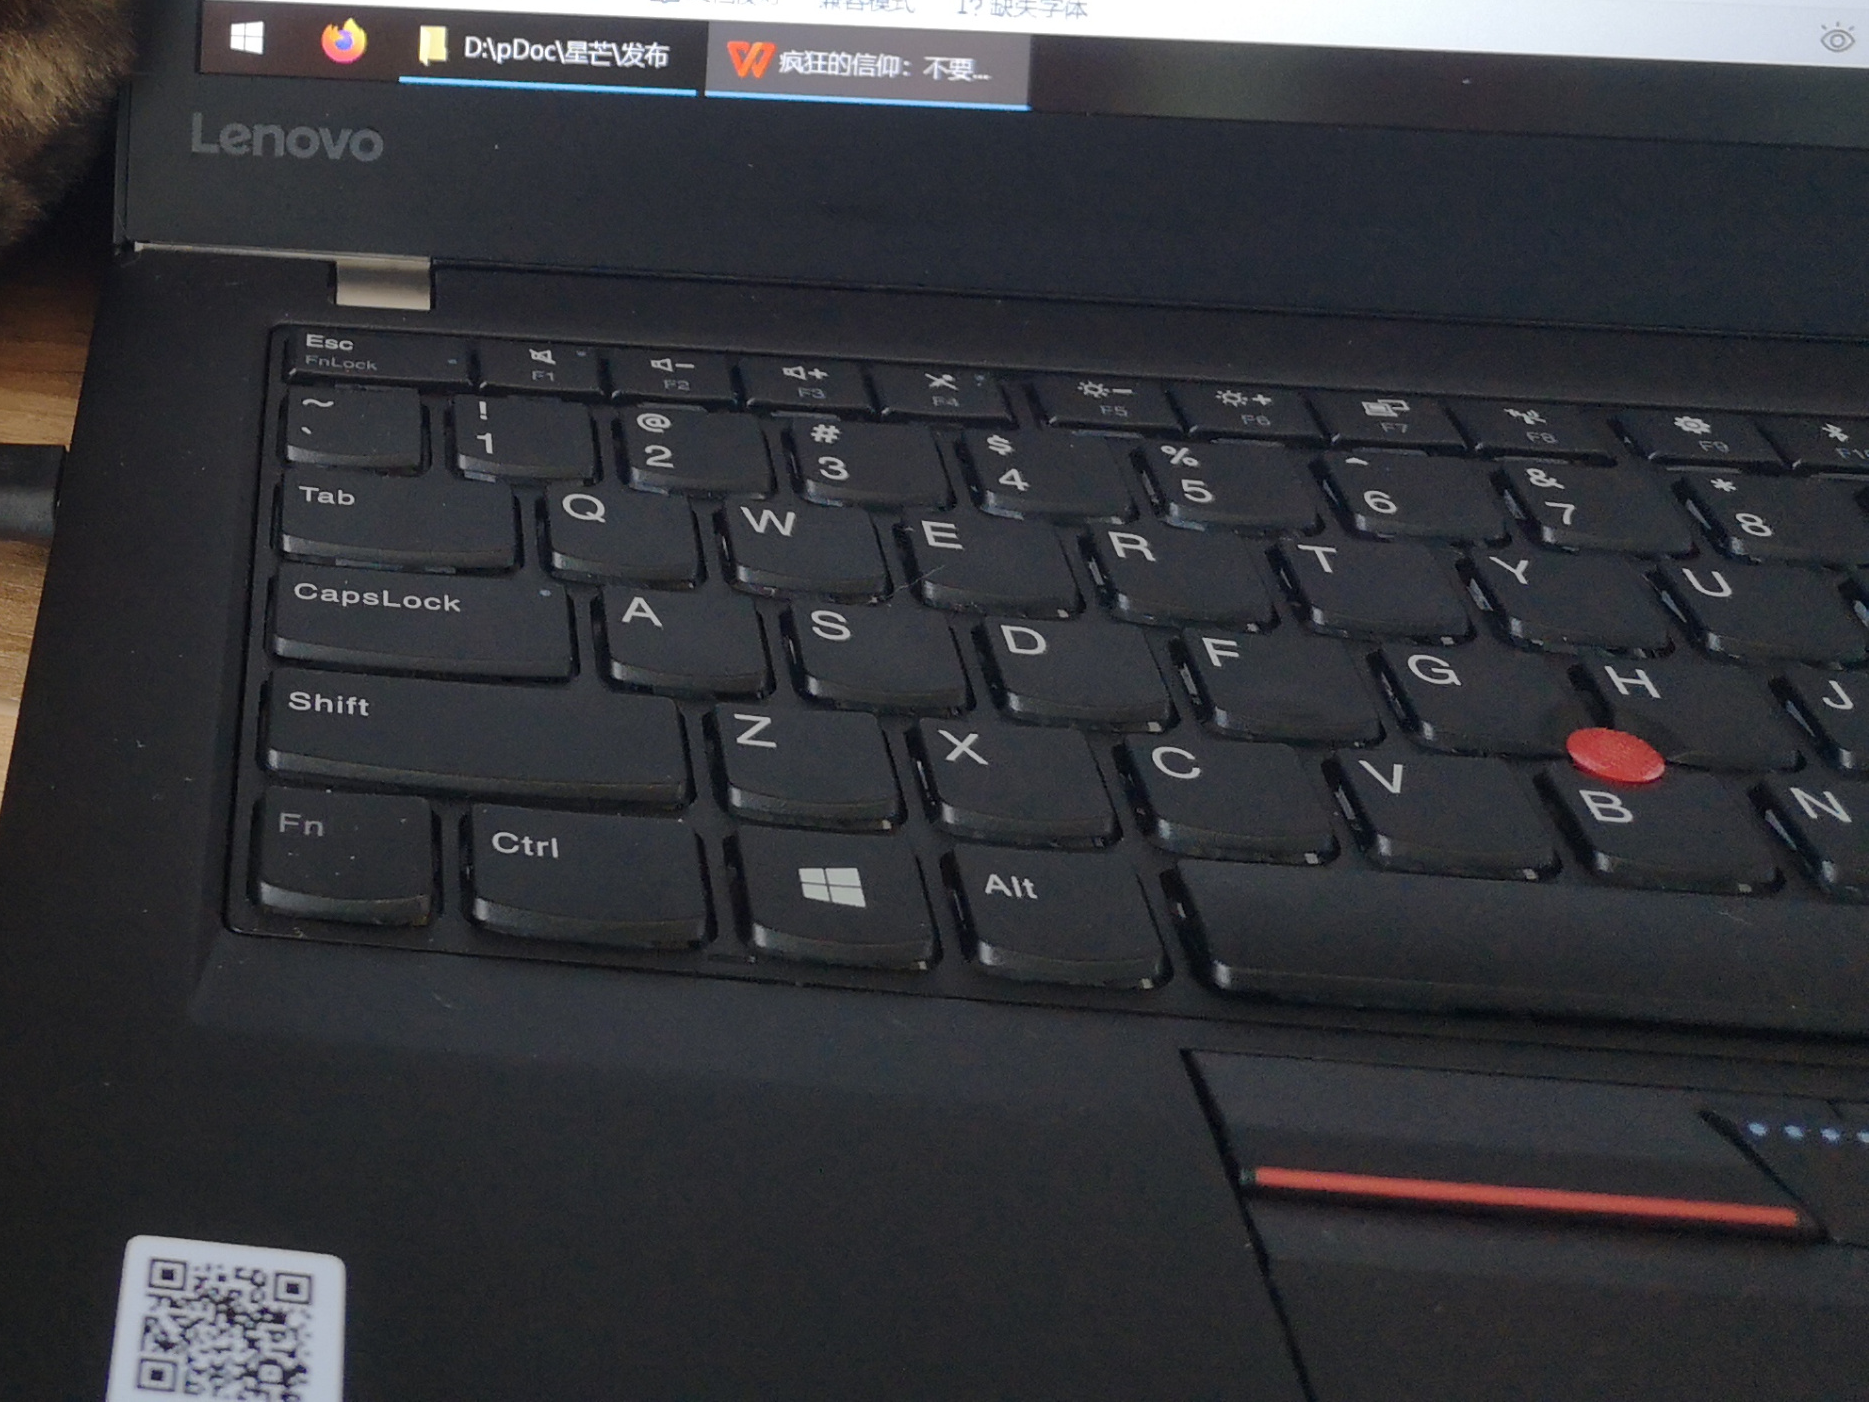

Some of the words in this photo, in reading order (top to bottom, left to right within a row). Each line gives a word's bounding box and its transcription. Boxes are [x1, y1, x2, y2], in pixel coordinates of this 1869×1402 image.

[190, 112, 384, 163] Lenovo
[306, 334, 354, 352] Esc
[305, 355, 377, 372] FnLock
[476, 432, 494, 455] 1
[644, 445, 674, 469] 2
[819, 456, 850, 481] 3
[998, 469, 1030, 492] 4
[298, 485, 356, 507] Tab
[1180, 478, 1214, 504] 5
[1363, 490, 1397, 515] 6
[562, 493, 606, 523] Q
[740, 505, 796, 537] W
[1544, 501, 1576, 525] 7
[921, 520, 965, 551] E
[1735, 513, 1773, 538] 8
[1107, 531, 1156, 562] R
[1297, 543, 1337, 574] T
[1489, 555, 1529, 586] Y
[1682, 568, 1732, 599] U
[293, 582, 462, 614] CapsLock
[621, 596, 663, 630] A
[810, 609, 852, 641] S
[1000, 624, 1047, 656] D
[1201, 636, 1240, 668] F
[1407, 653, 1462, 687] G
[1604, 666, 1662, 699] H
[288, 691, 370, 717] Shift
[1821, 680, 1855, 710] J
[733, 713, 777, 748] Z
[937, 729, 989, 766] X
[1151, 745, 1201, 780] C
[1358, 759, 1404, 794] V
[1578, 789, 1634, 823] B
[1789, 787, 1852, 823] N
[278, 812, 324, 838] Fn
[491, 831, 559, 859] Ctrl
[985, 874, 1038, 899] Alt
